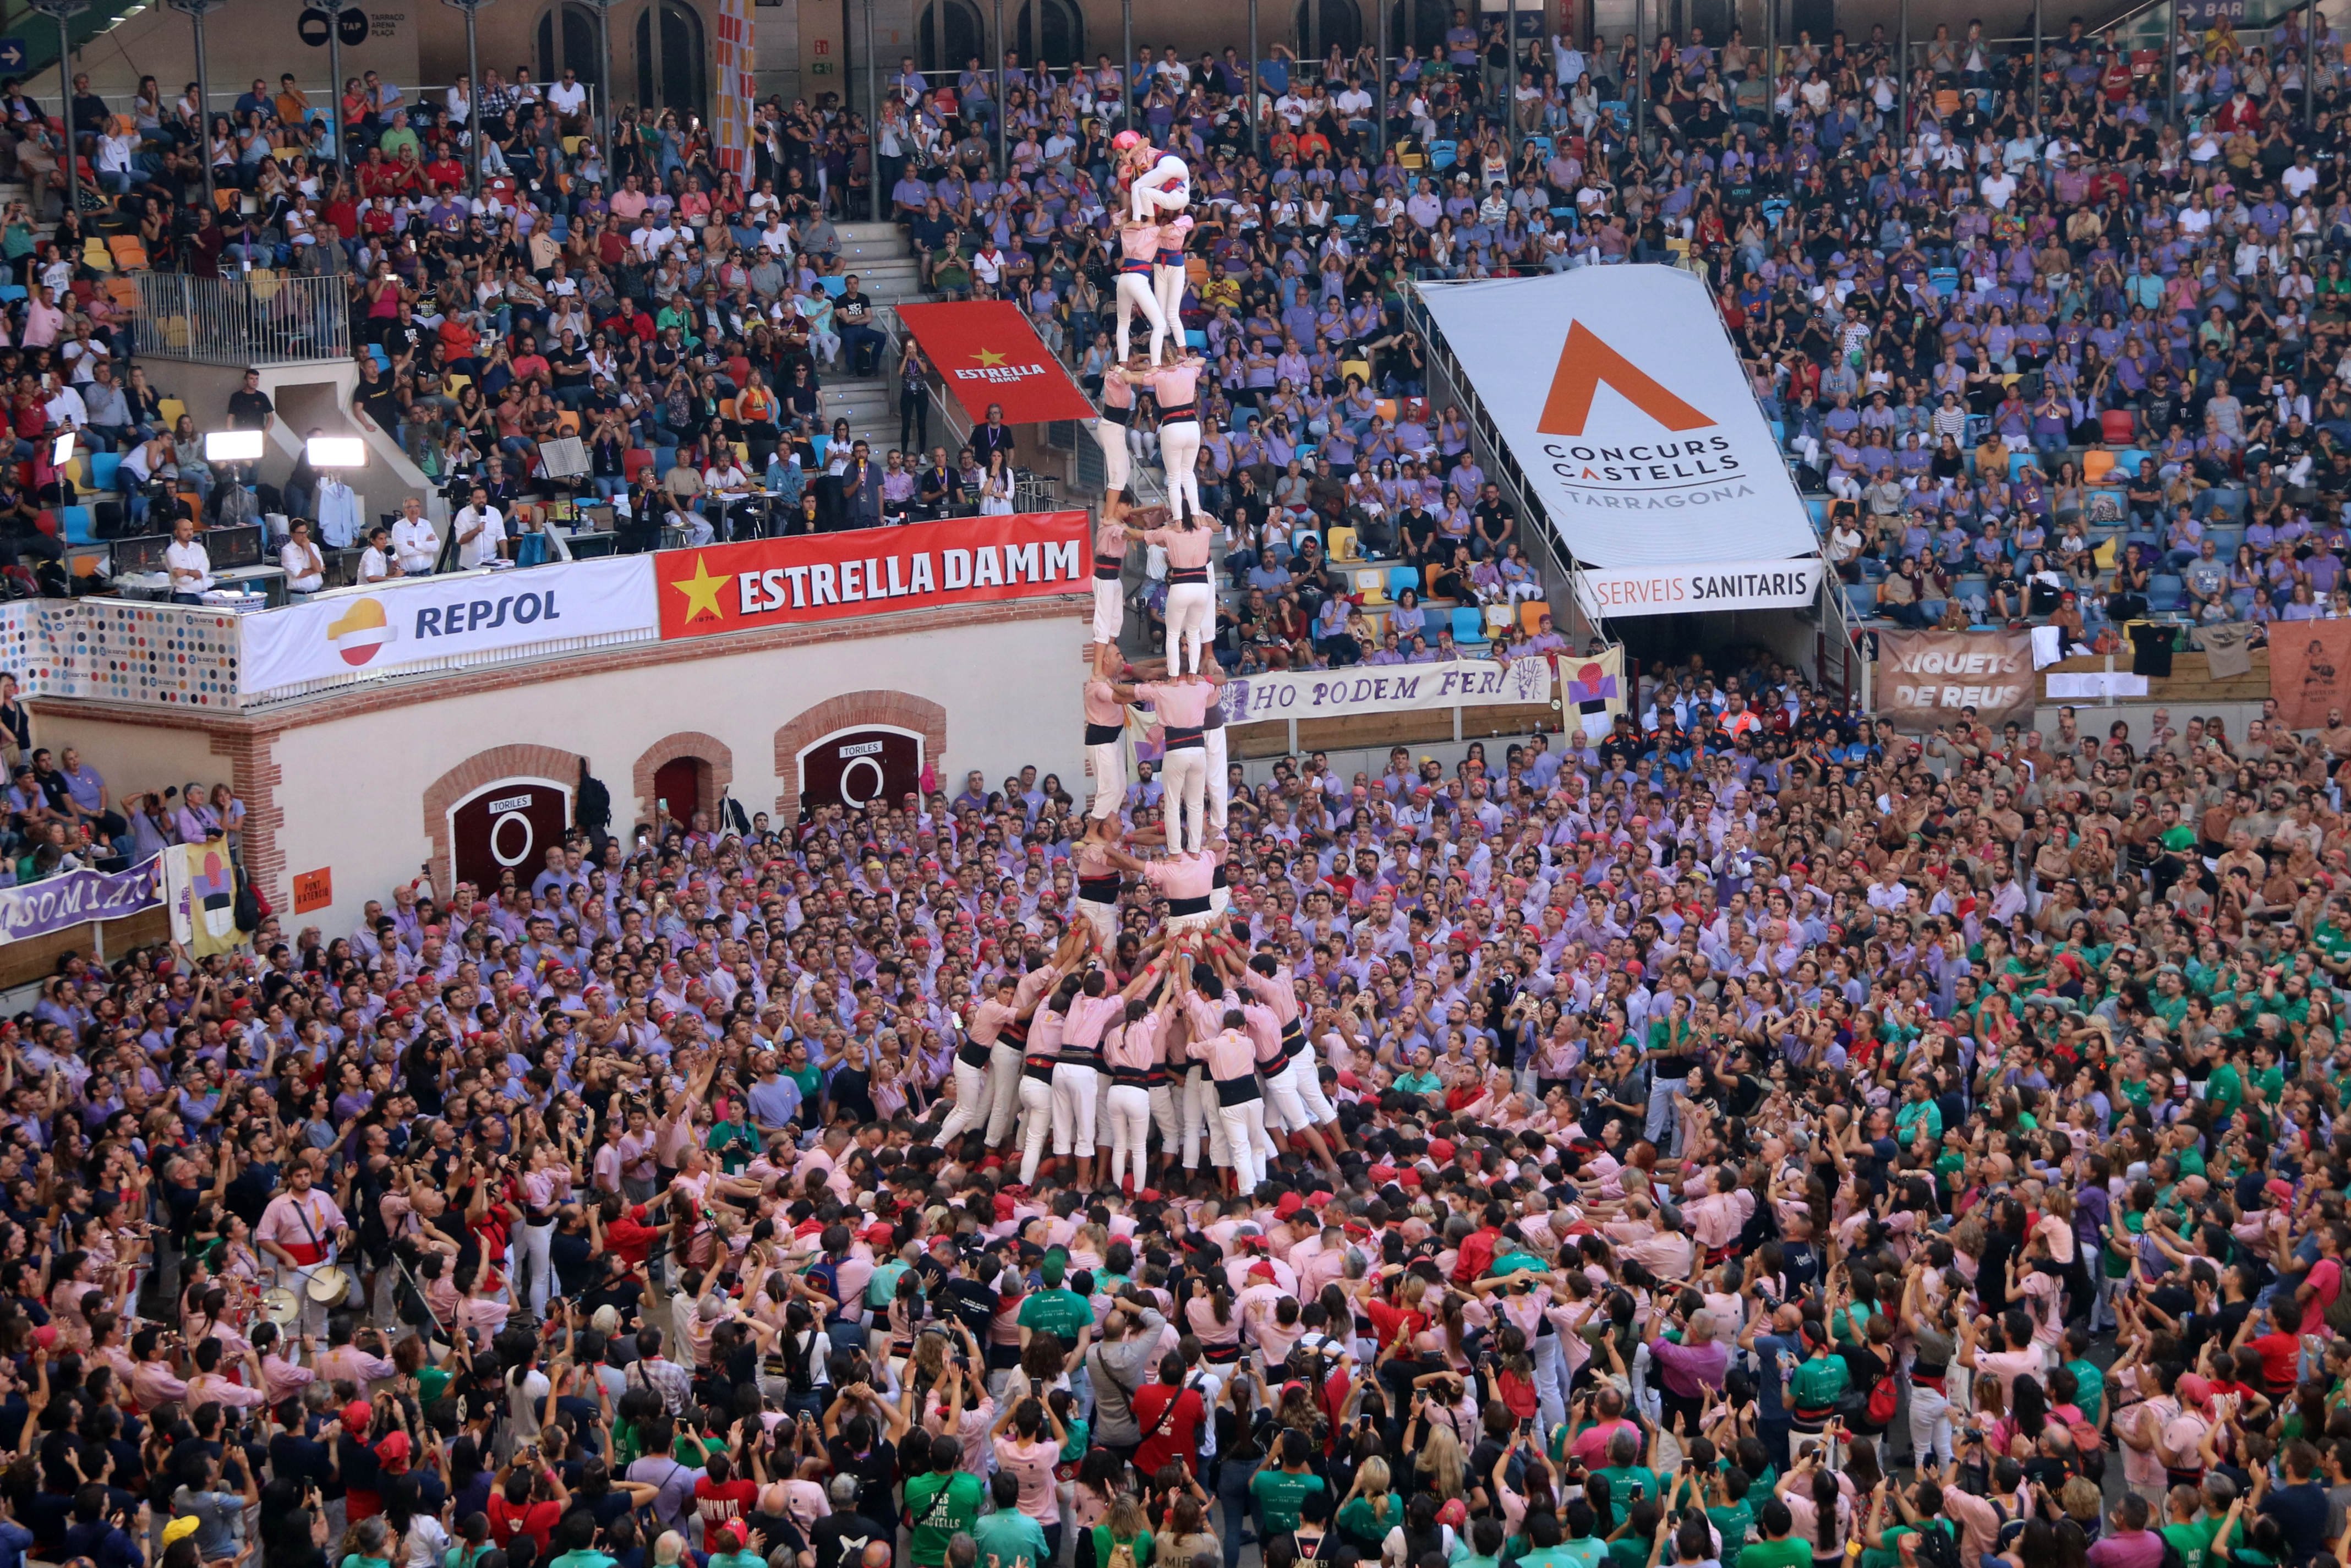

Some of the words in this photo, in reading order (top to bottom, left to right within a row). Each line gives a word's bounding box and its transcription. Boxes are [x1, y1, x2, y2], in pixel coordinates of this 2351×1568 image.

[2204, 2, 2243, 17] BAR
[342, 23, 362, 31] TAP
[955, 364, 1046, 379] ESTRELLA
[989, 375, 1021, 384] DAMM
[1543, 436, 1730, 462] CONCURS
[1552, 454, 1739, 481] CASTELLS
[1565, 484, 1756, 510] TARRAGONA
[737, 552, 937, 614] ESTRELLA
[943, 539, 1081, 591] DAMM
[1597, 577, 1684, 605] SERVEIS
[1692, 572, 1807, 600] SANITARIS
[416, 590, 560, 639] REPSOL
[1890, 652, 2021, 674] XIQUETS
[1254, 684, 1296, 709] HO
[1313, 675, 1420, 706] PODEM
[1437, 667, 1507, 696] FER!
[1894, 685, 1936, 707] DE
[1940, 685, 2021, 708] REUS
[844, 743, 878, 756] TORILES
[494, 797, 527, 811] TORILES
[304, 881, 320, 892] PUNT
